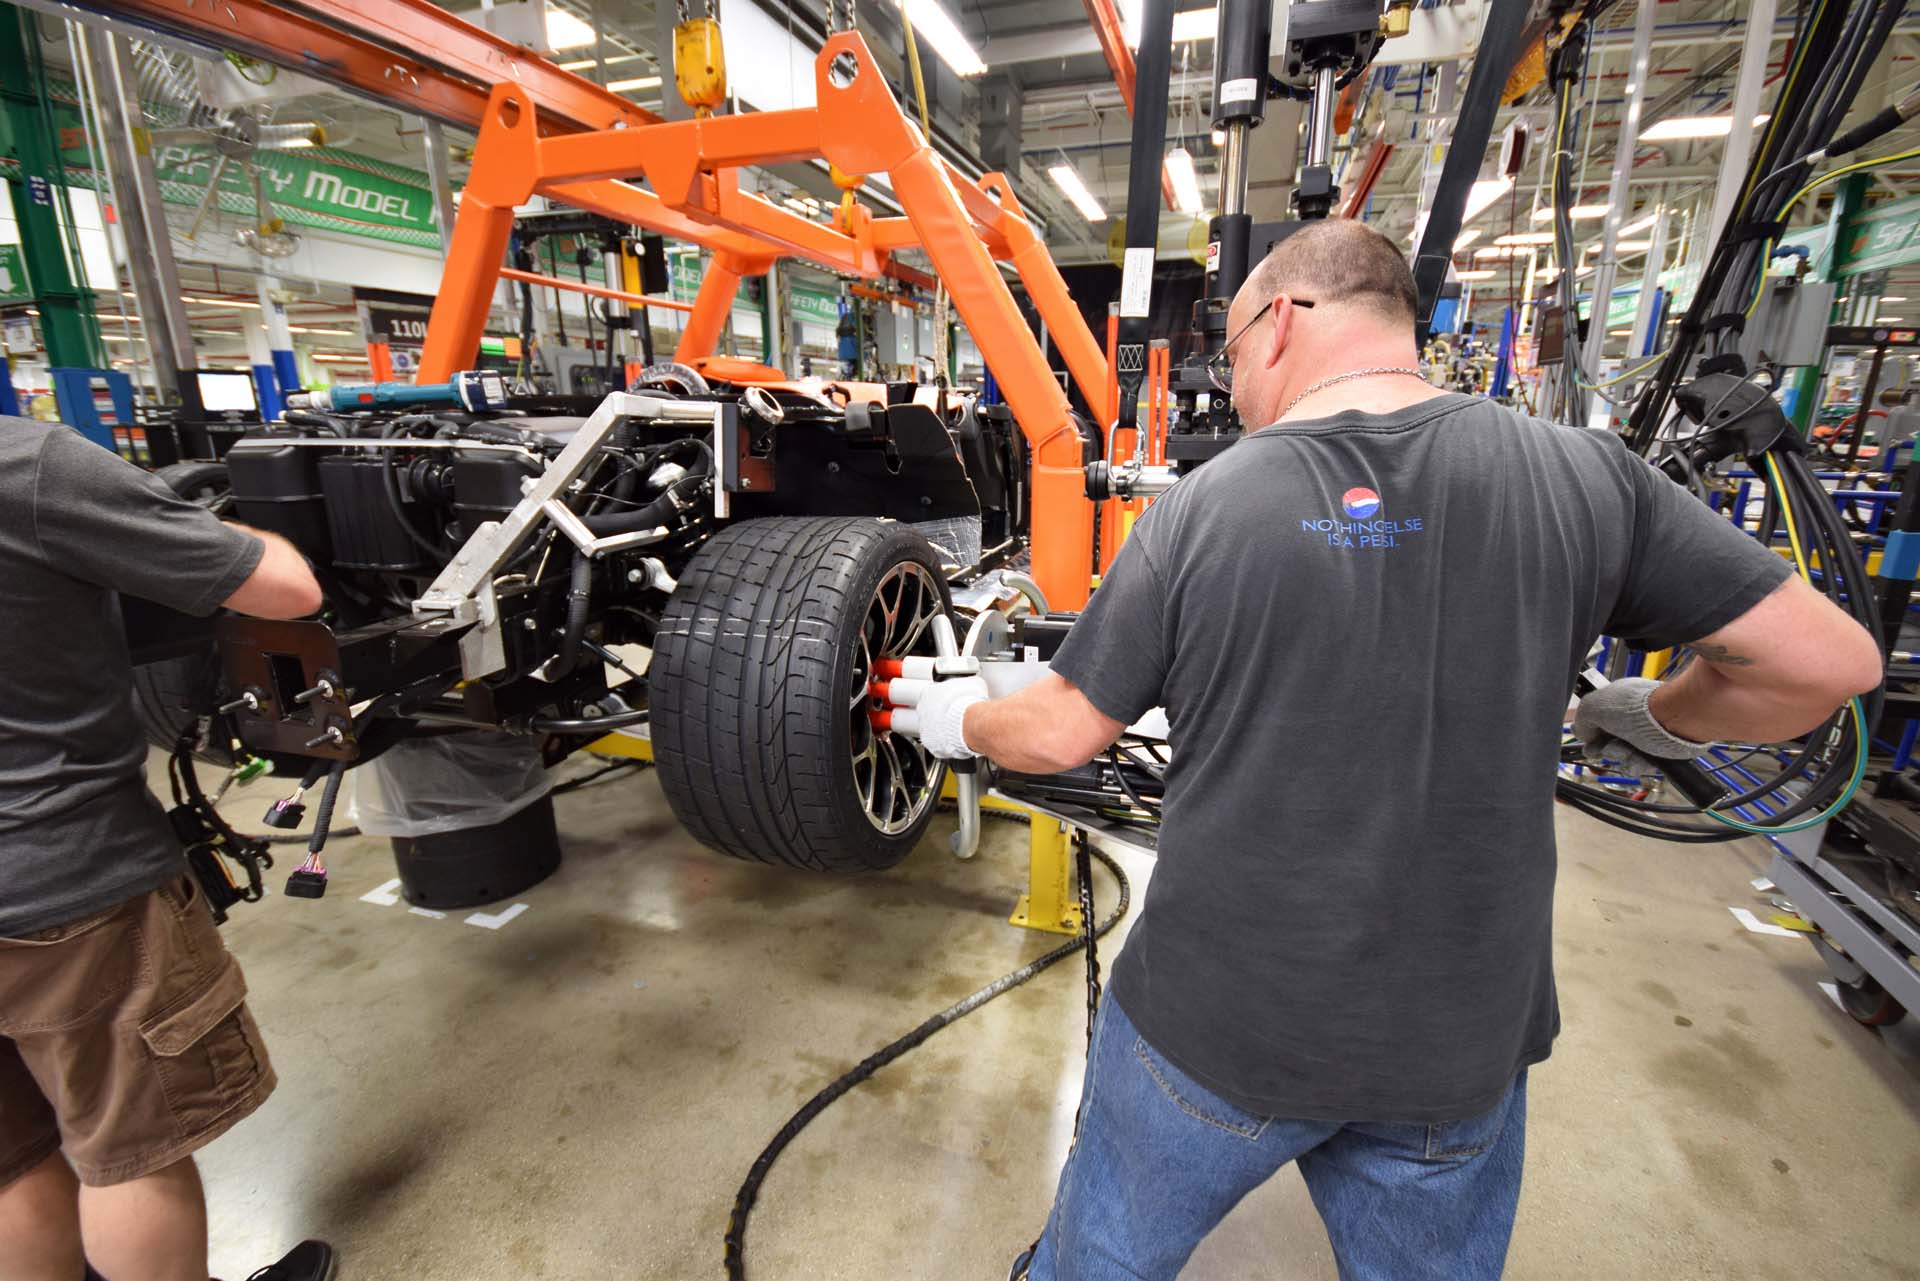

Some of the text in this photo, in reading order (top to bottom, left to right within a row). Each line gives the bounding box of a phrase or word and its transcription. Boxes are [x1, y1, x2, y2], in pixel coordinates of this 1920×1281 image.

[303, 169, 419, 223] MODEL
[1384, 518, 1424, 534] ELSE
[1328, 533, 1341, 546] IS
[1343, 536, 1355, 549] A
